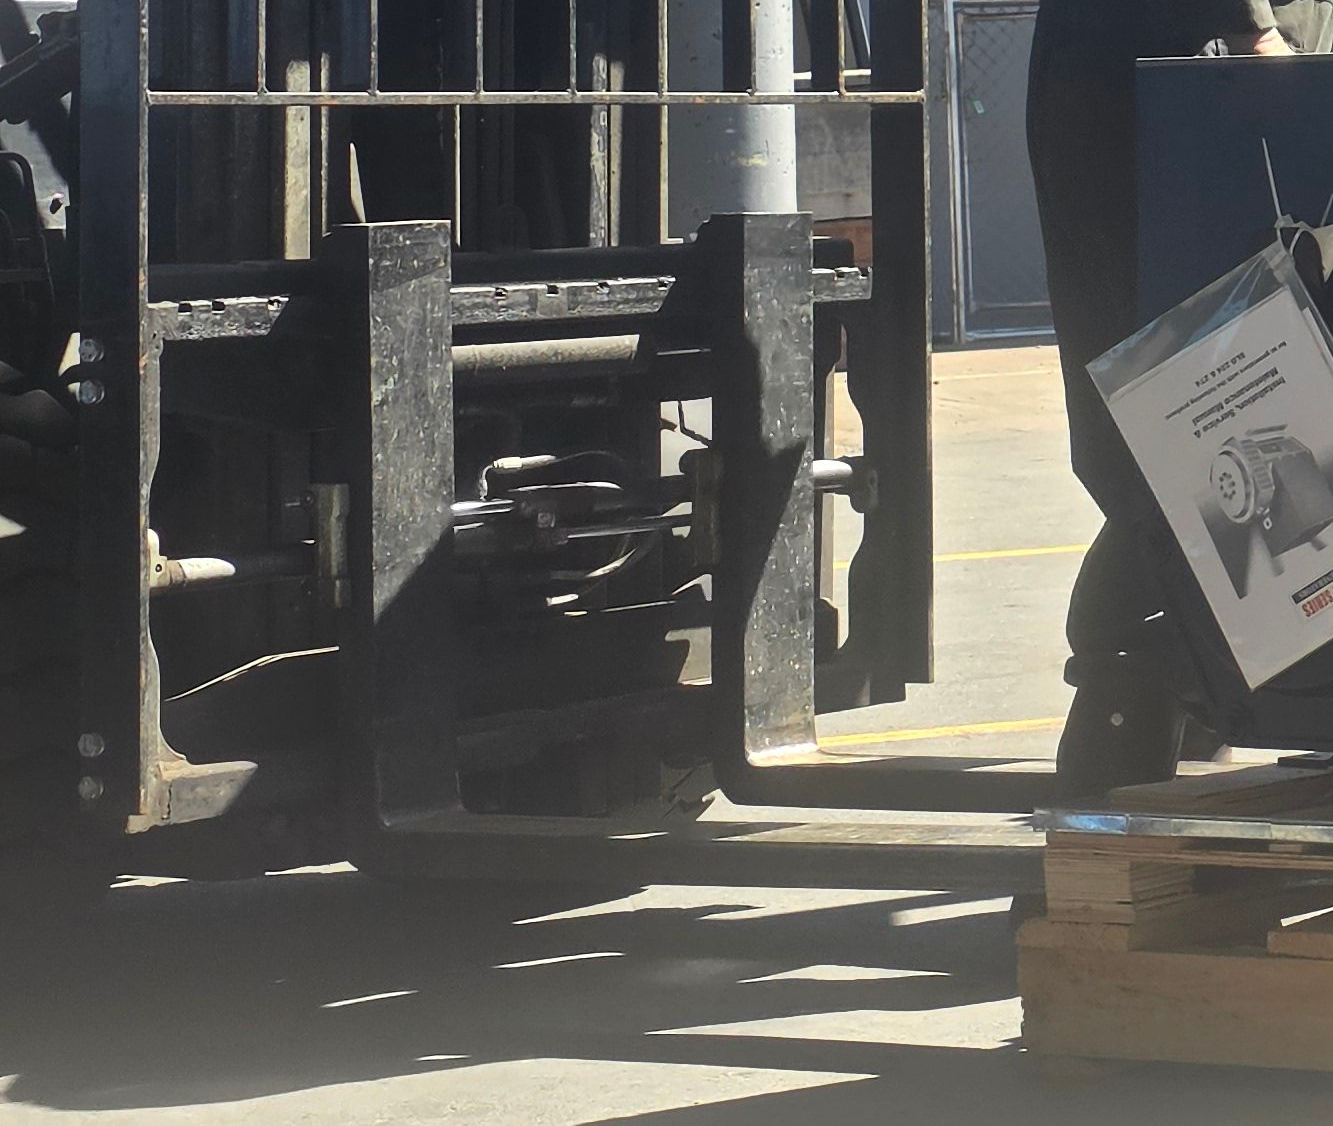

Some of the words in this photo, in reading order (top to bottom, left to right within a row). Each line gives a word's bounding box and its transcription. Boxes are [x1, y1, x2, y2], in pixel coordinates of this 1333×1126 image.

[1222, 366, 1279, 405] Maintenance
[1192, 402, 1224, 425] Manual
[1202, 409, 1236, 433] Service
[1301, 590, 1333, 617] SERIES
